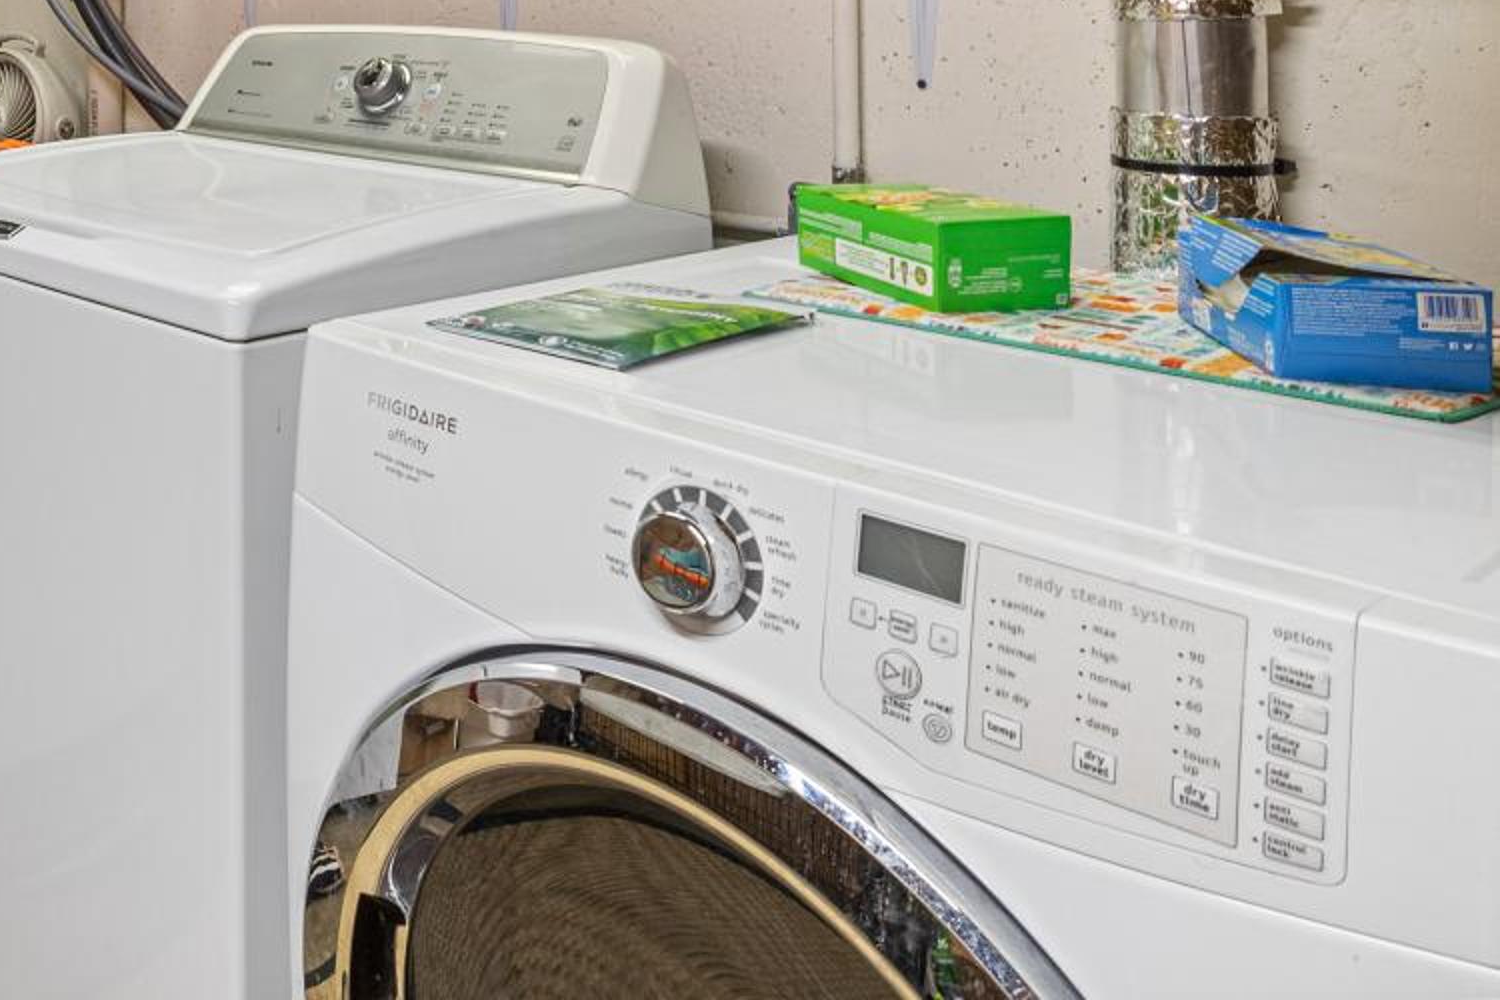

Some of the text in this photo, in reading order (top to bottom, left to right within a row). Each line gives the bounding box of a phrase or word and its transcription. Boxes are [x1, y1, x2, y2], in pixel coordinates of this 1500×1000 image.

[367, 391, 458, 435] FRIGIDAIRE
[388, 428, 430, 455] affinity
[1016, 571, 1196, 634] ready steam system
[999, 618, 1025, 638] high
[1272, 625, 1334, 652] options
[997, 643, 1037, 664] normal
[1090, 645, 1119, 665] high
[1188, 651, 1206, 666] 90
[1089, 671, 1132, 693] normal
[1188, 676, 1204, 690] 75
[1185, 699, 1203, 714] 60
[987, 720, 1018, 741] temp
[1185, 723, 1201, 738] 30
[1083, 750, 1105, 767] dry
[1182, 747, 1221, 770] touch
[1182, 764, 1200, 777] up
[1179, 793, 1211, 813] time
[1183, 784, 1207, 802] dry
